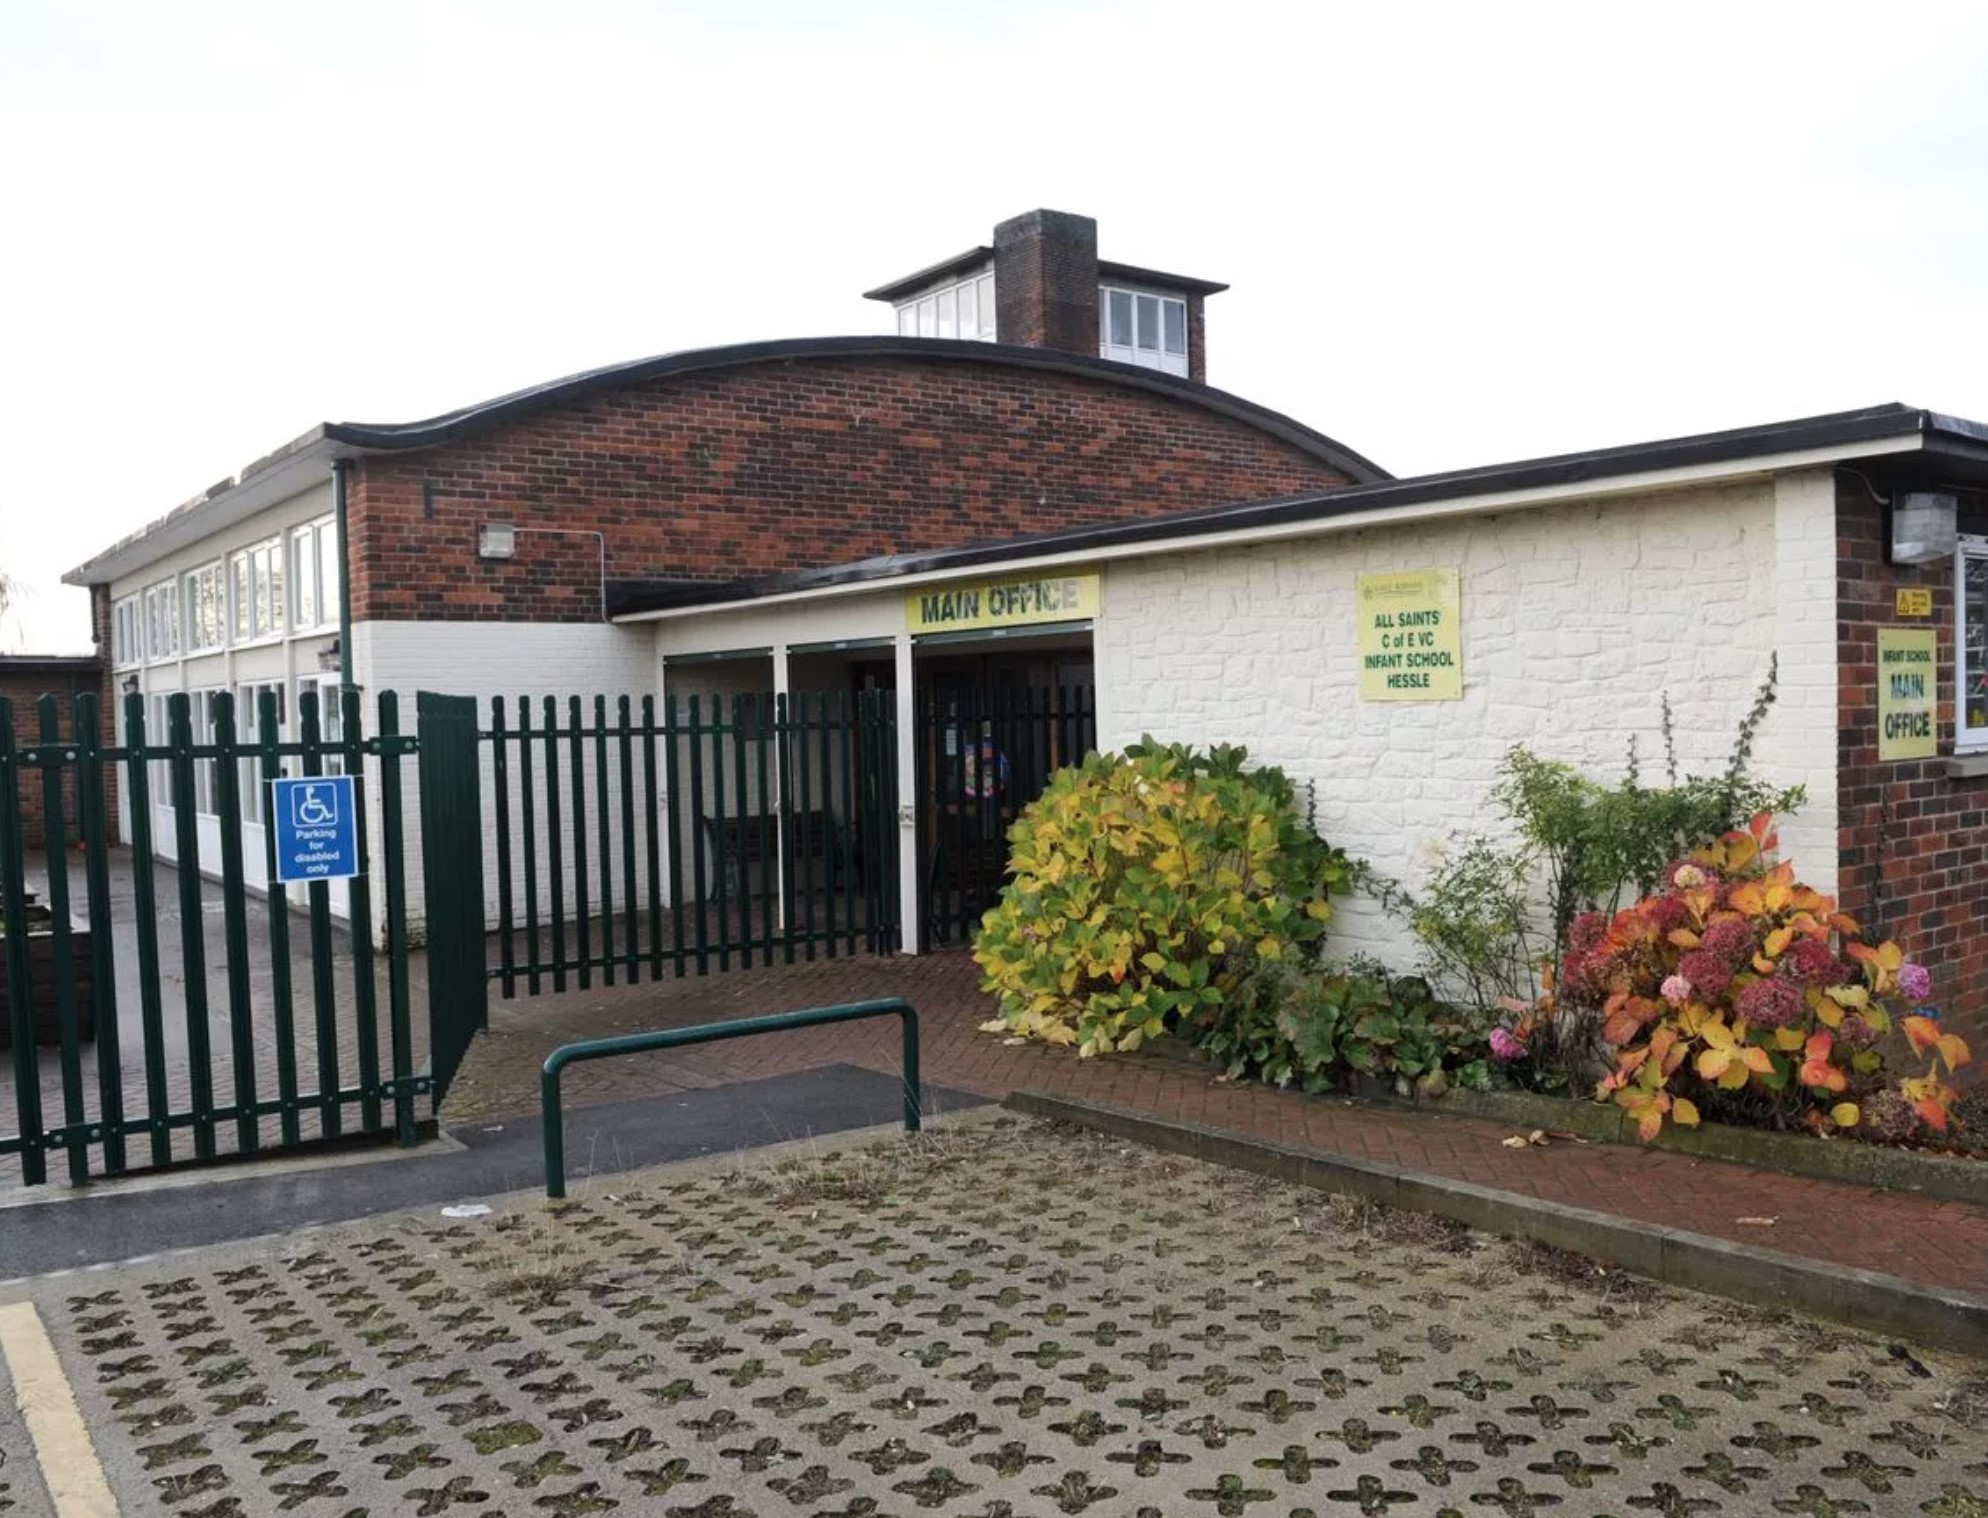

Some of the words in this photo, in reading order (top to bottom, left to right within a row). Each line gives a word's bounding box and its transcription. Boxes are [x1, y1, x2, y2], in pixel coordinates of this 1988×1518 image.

[921, 590, 979, 624] MAIN
[988, 579, 1079, 616] OFFICE
[1375, 614, 1395, 628] ALL
[1382, 633, 1390, 648] C
[1394, 633, 1404, 647] of
[1407, 632, 1415, 647] E
[1418, 631, 1434, 646] VC
[1364, 653, 1402, 669] INFANT
[1406, 651, 1455, 668] SCHOOL
[1883, 650, 1904, 662] INFANT
[1906, 649, 1931, 662] SCHOOL
[1387, 672, 1430, 688] HESSLE
[1891, 674, 1924, 699] MAIN
[1885, 711, 1931, 739] OFFICE
[295, 829, 338, 840] Parking
[309, 841, 324, 850] for
[294, 850, 340, 863] disabled
[306, 863, 330, 873] only
